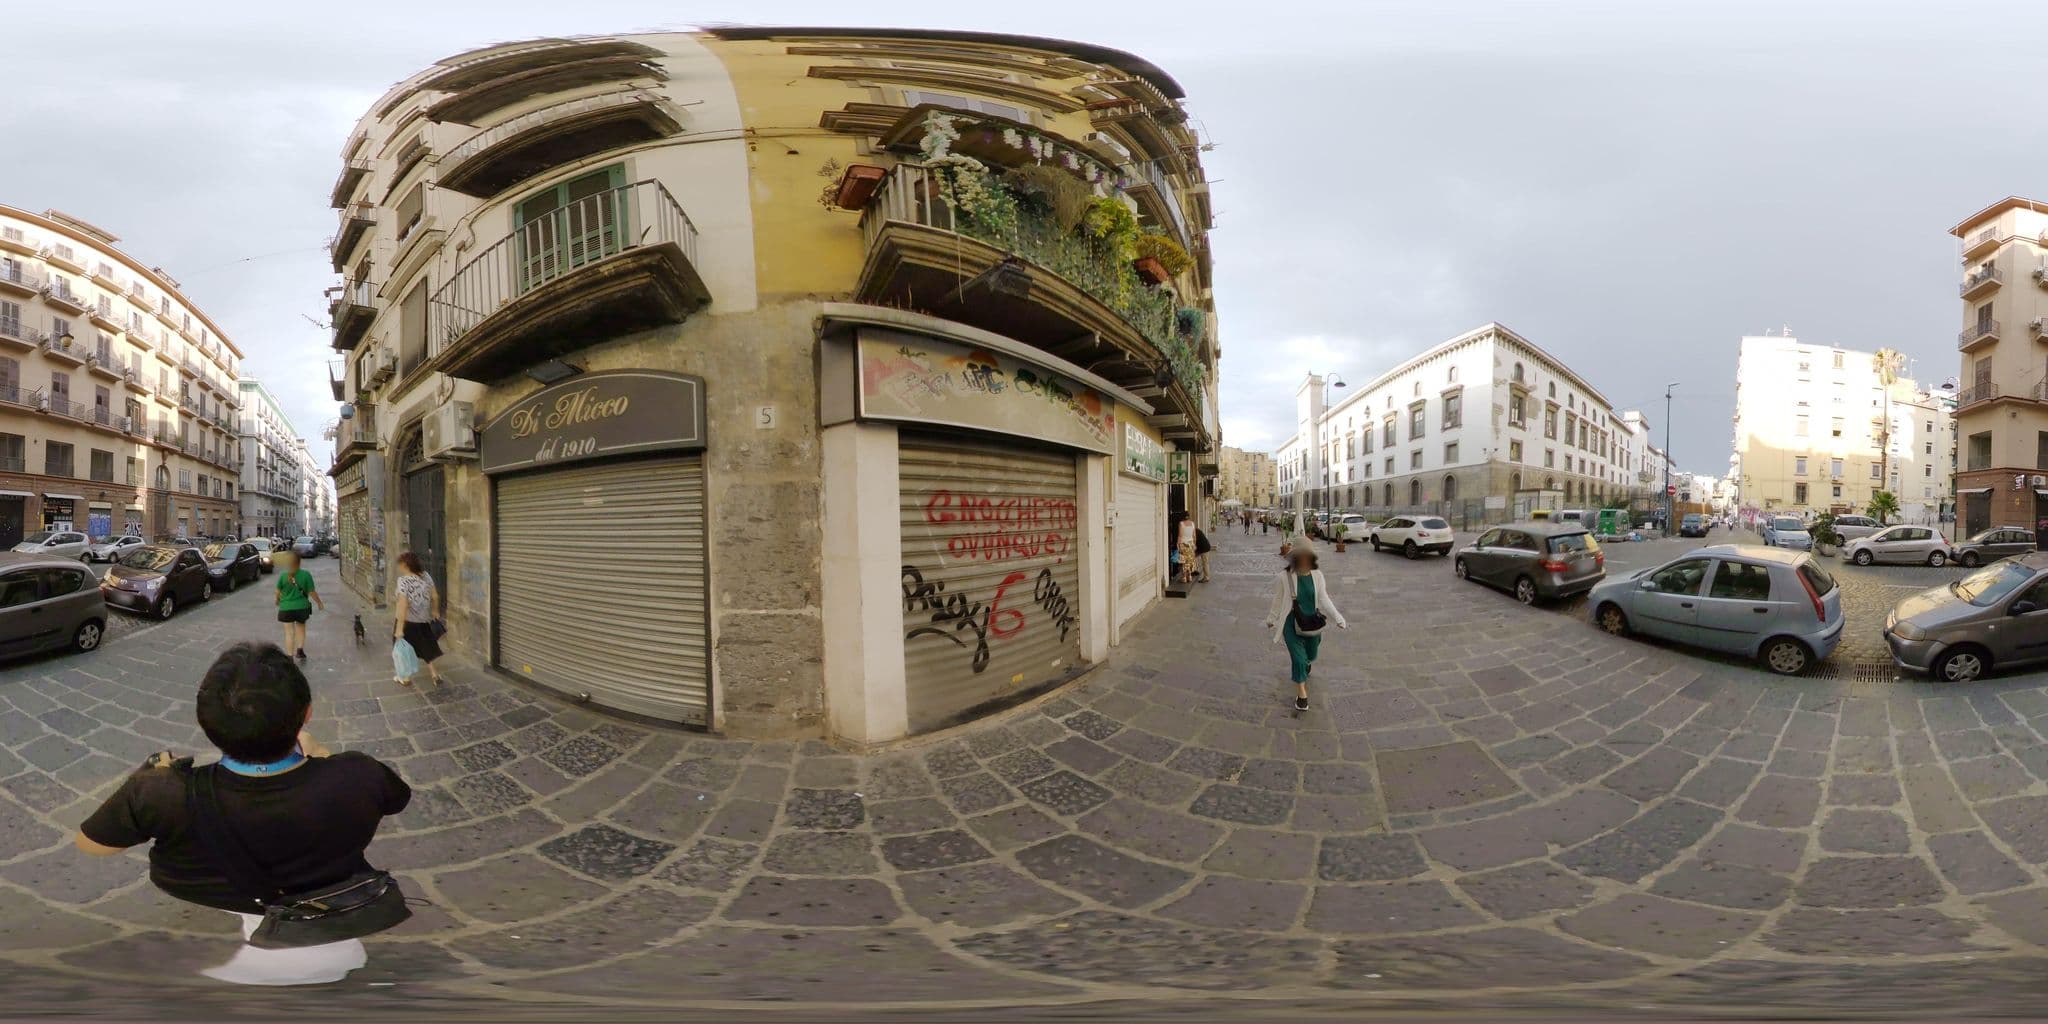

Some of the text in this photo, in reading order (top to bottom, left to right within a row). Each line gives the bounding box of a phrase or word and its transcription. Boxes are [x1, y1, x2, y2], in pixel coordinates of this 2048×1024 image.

[511, 386, 629, 439] Di Micco
[761, 407, 772, 425] 5
[535, 435, 597, 463] dal 1910
[1171, 473, 1187, 483] 24
[988, 571, 1026, 640] 6
